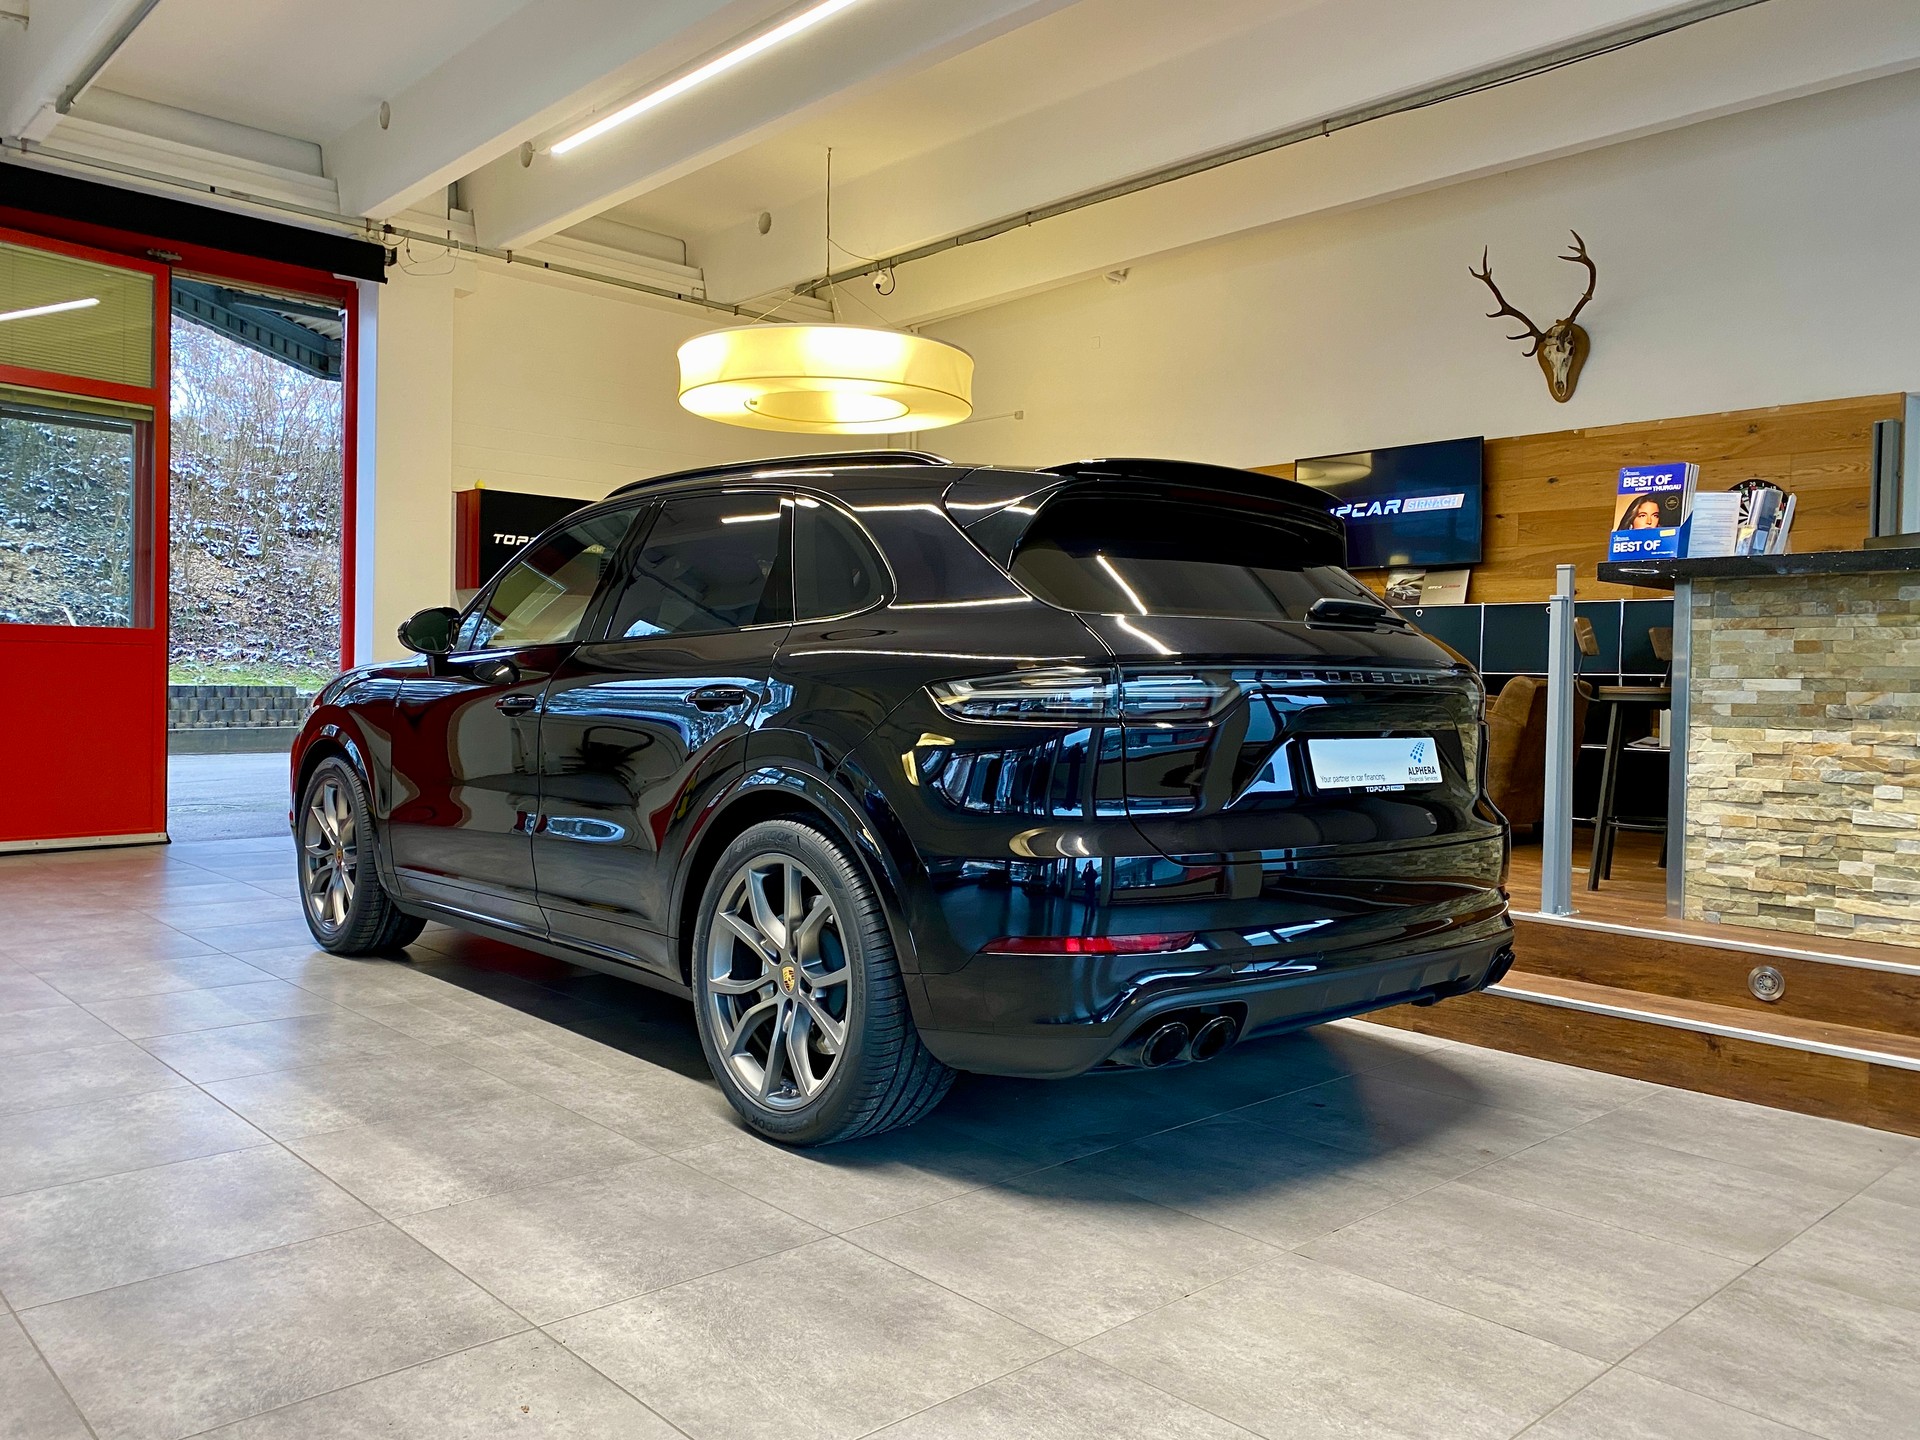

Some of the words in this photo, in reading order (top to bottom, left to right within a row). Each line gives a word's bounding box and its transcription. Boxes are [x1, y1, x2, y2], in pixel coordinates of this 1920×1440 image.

[1622, 475, 1654, 488] BEST
[1655, 474, 1673, 485] OF
[1329, 499, 1402, 518] PCAR
[1408, 497, 1458, 510] SIRNACH
[1612, 540, 1642, 553] BEST
[1643, 539, 1661, 551] OF
[1300, 671, 1437, 685] PORSCHE
[1408, 765, 1437, 776] ALPHERA
[1320, 775, 1331, 783] Your
[1333, 775, 1350, 783] partner
